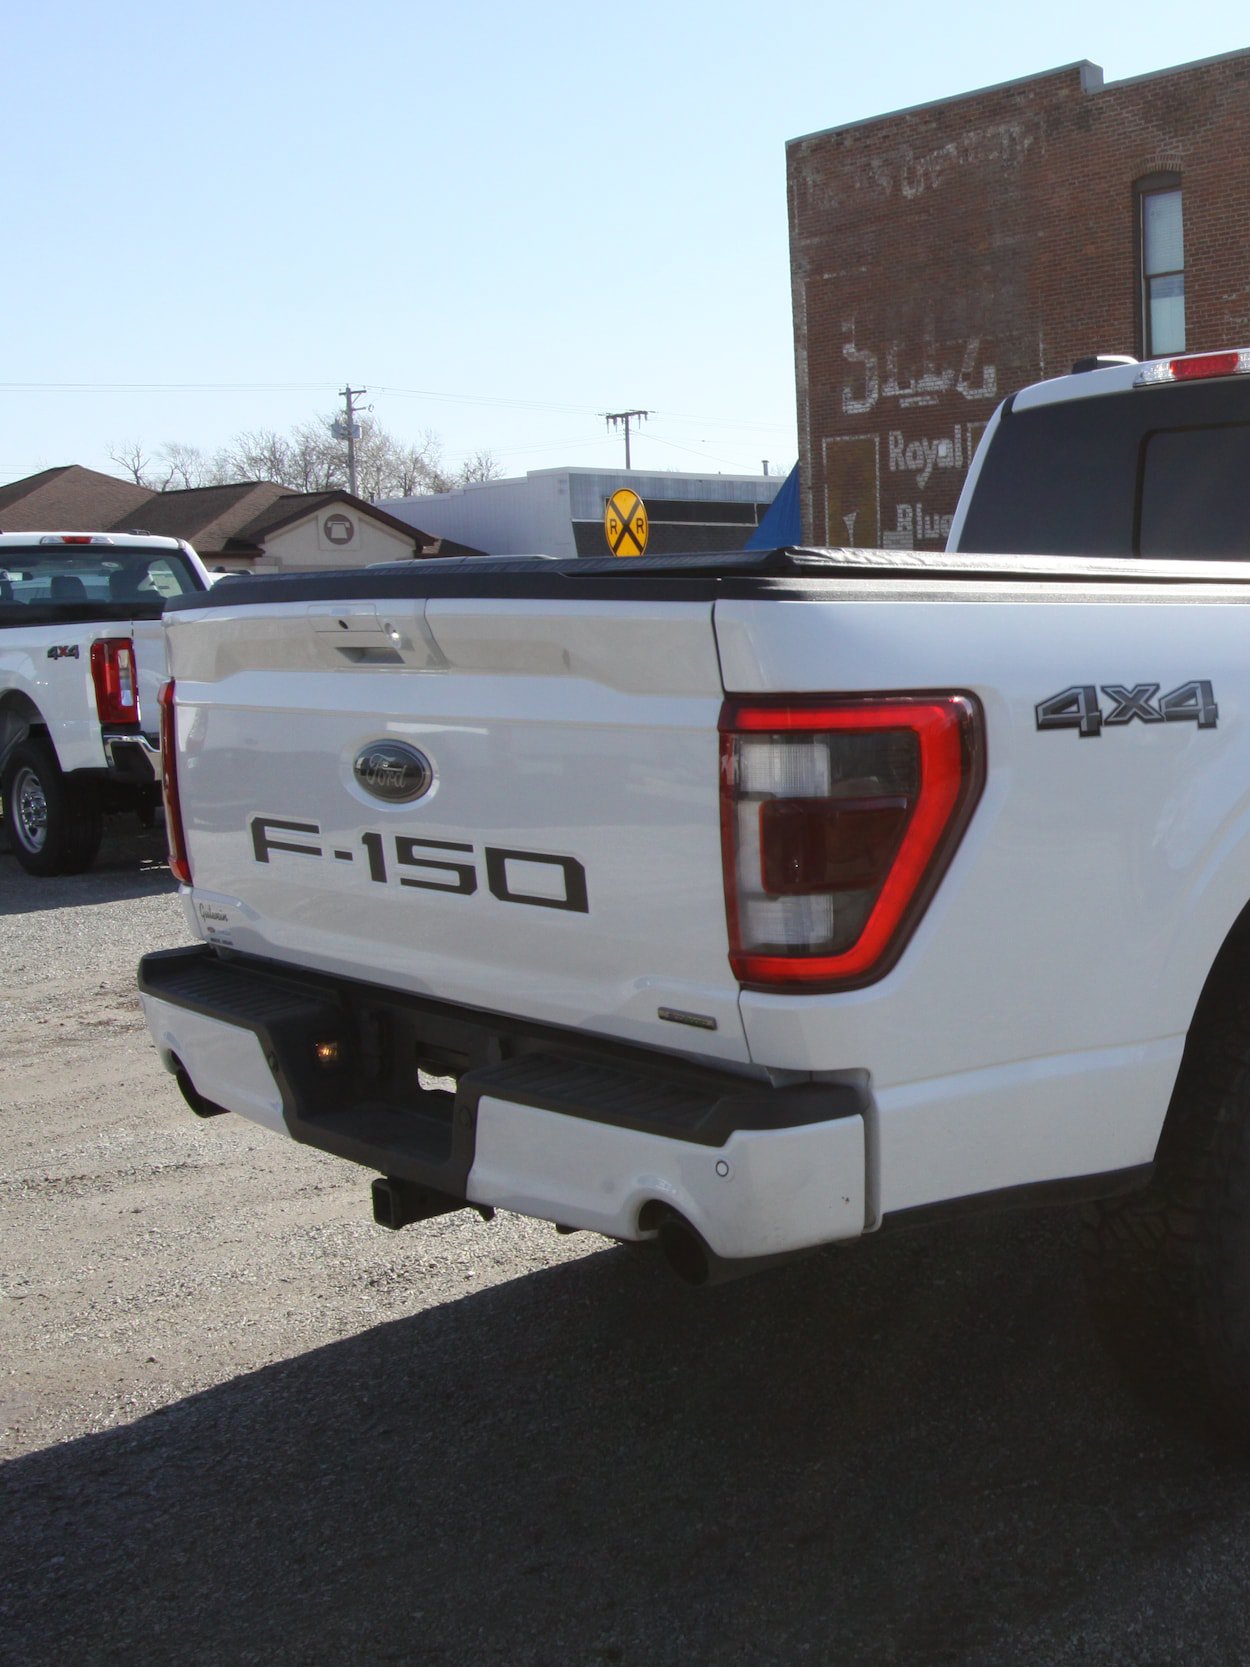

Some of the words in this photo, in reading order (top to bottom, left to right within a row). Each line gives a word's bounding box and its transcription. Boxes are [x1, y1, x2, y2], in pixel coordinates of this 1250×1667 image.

[888, 424, 963, 489] Royal
[366, 753, 407, 788] Ford
[250, 816, 590, 914] F-150
